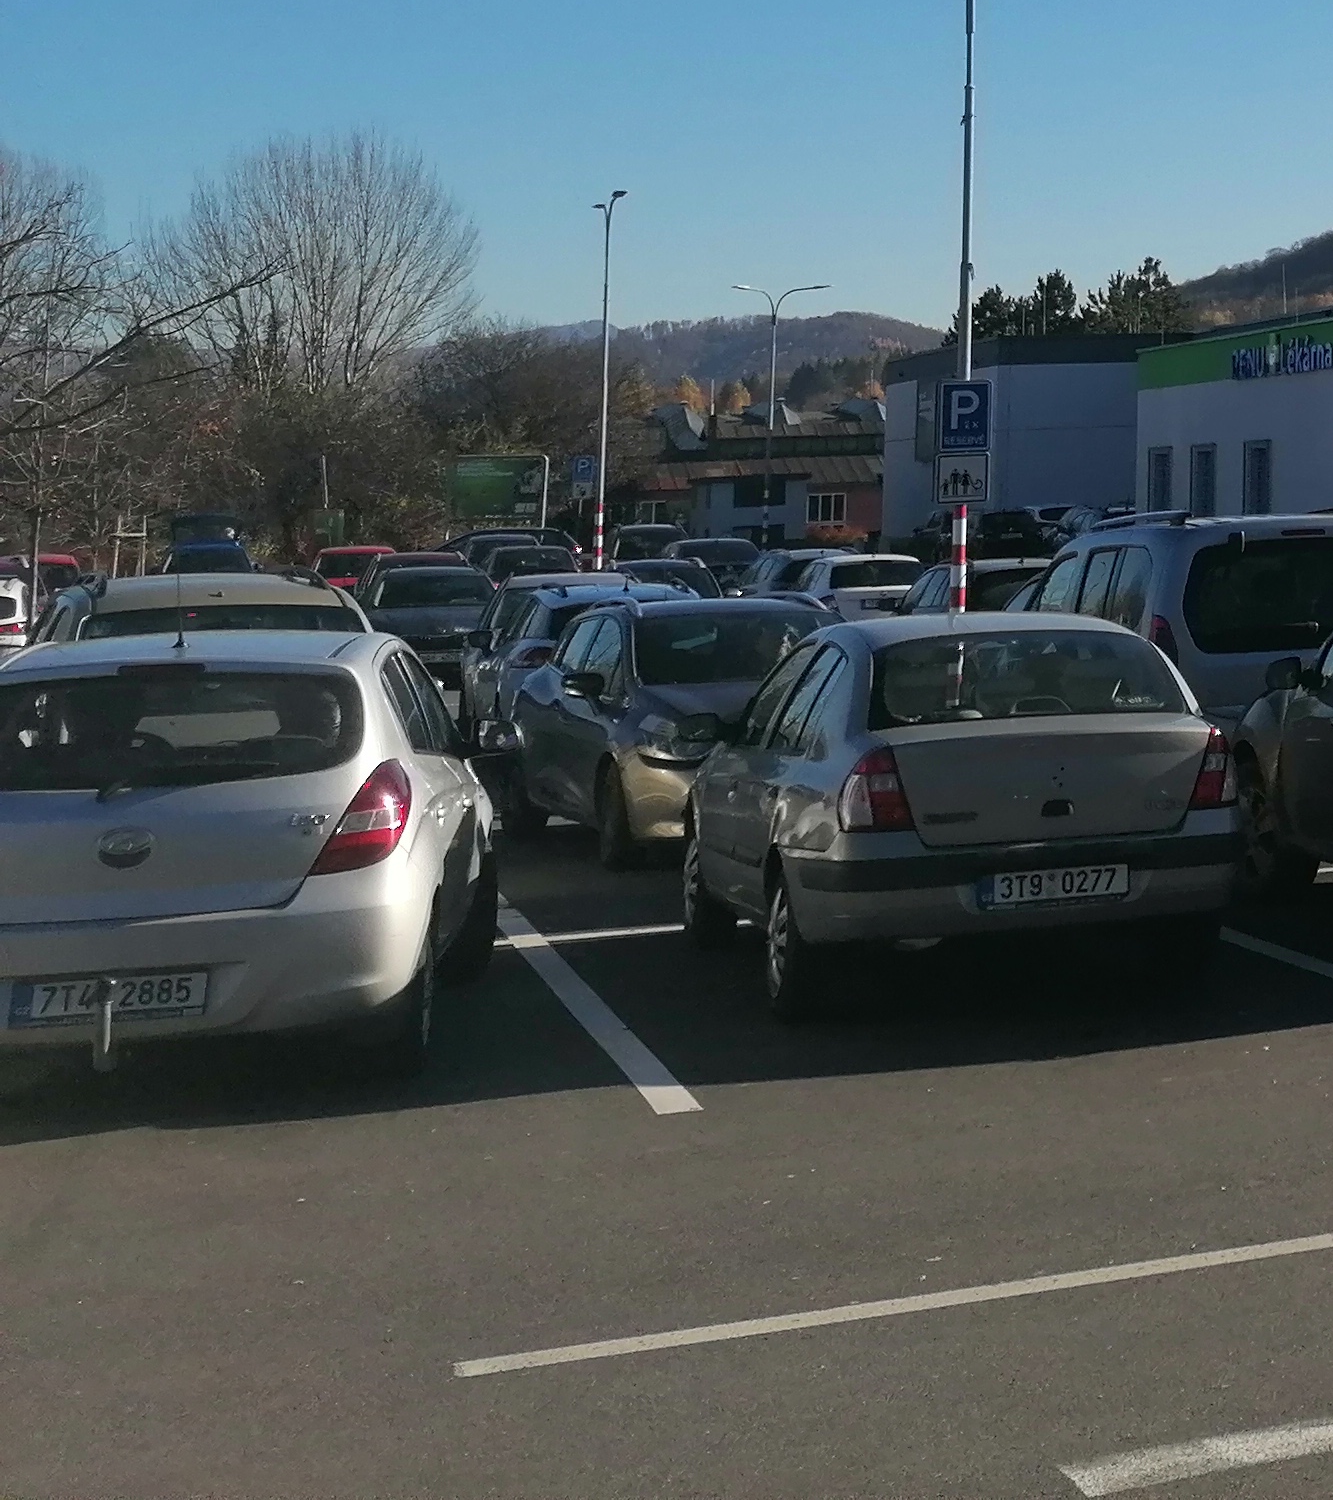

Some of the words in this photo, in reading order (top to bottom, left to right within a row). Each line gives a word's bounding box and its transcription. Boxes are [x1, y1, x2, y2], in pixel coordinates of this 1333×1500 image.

[950, 389, 980, 430] P
[577, 459, 590, 473] P
[1000, 873, 1043, 900] 3T9
[1061, 867, 1117, 895] 0277
[118, 976, 194, 1009] 2885
